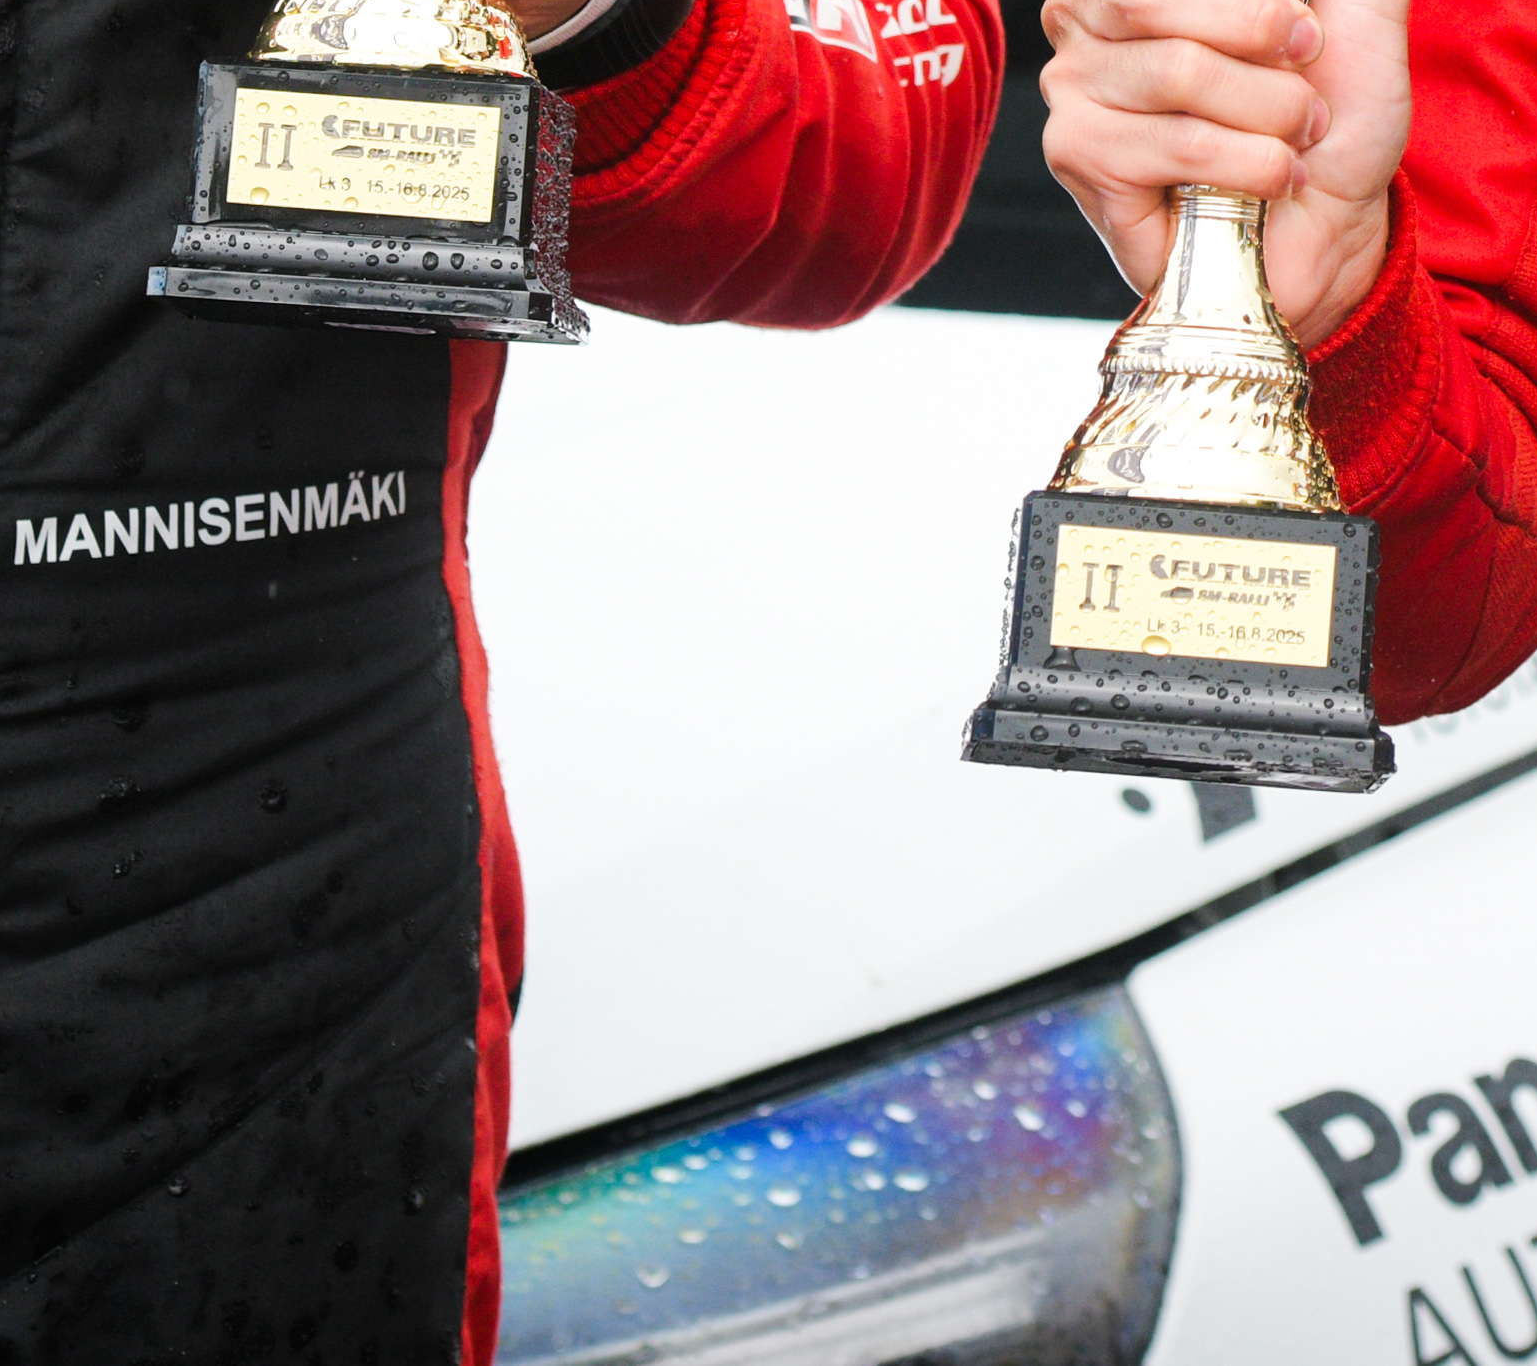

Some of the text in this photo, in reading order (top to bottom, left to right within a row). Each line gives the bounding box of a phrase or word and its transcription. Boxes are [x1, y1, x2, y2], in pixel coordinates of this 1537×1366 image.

[254, 122, 297, 171] II
[341, 119, 477, 147] FUTURE
[15, 469, 408, 568] MANNISENMÄKI
[1077, 561, 1124, 613] II
[1170, 559, 1312, 589] FUTURE
[1197, 622, 1306, 646] 15.-16.8.2025
